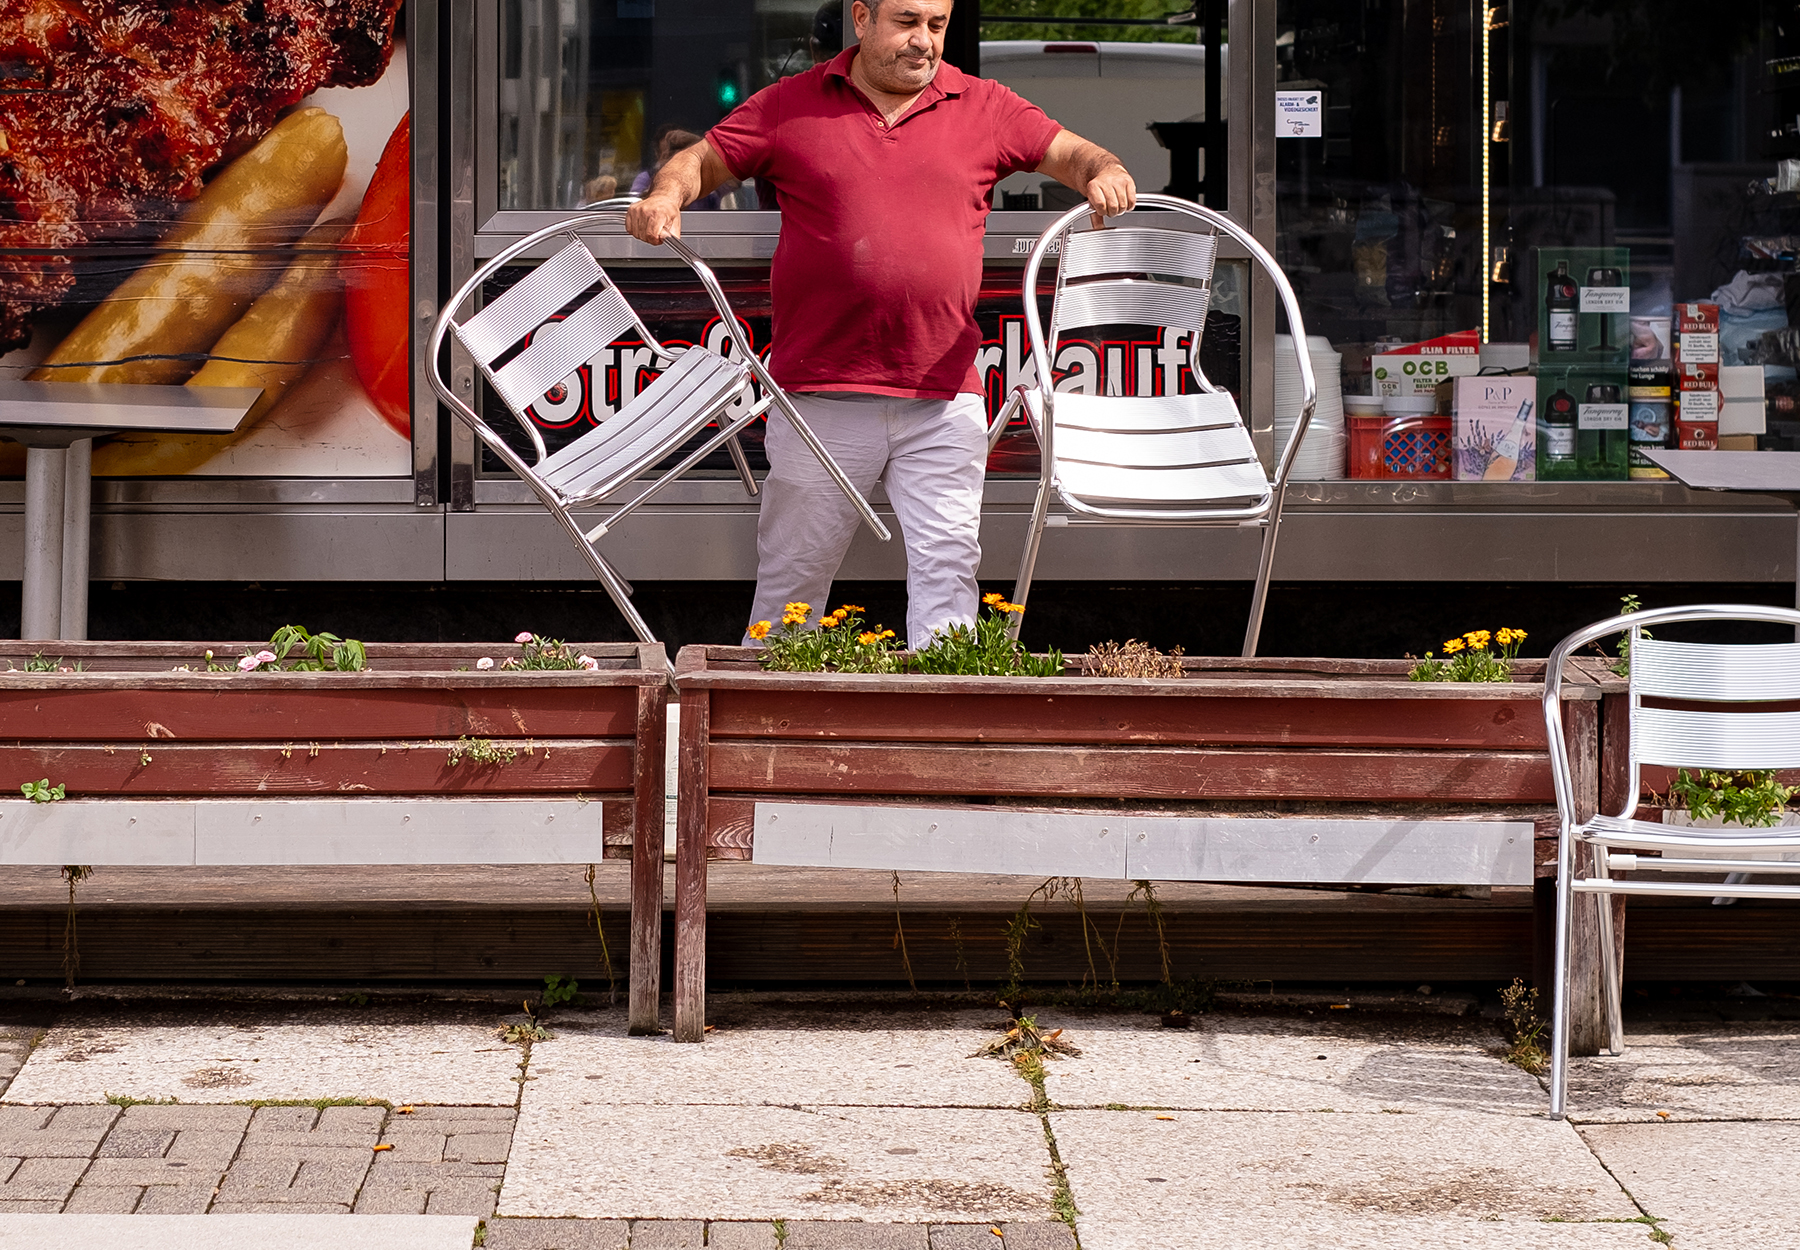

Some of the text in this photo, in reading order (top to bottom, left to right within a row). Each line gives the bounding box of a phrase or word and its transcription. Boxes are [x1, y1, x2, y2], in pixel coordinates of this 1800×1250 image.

[1420, 346, 1475, 354] SLIM FILTER
[1402, 361, 1448, 375] OCB
[1484, 386, 1512, 401] P&P
